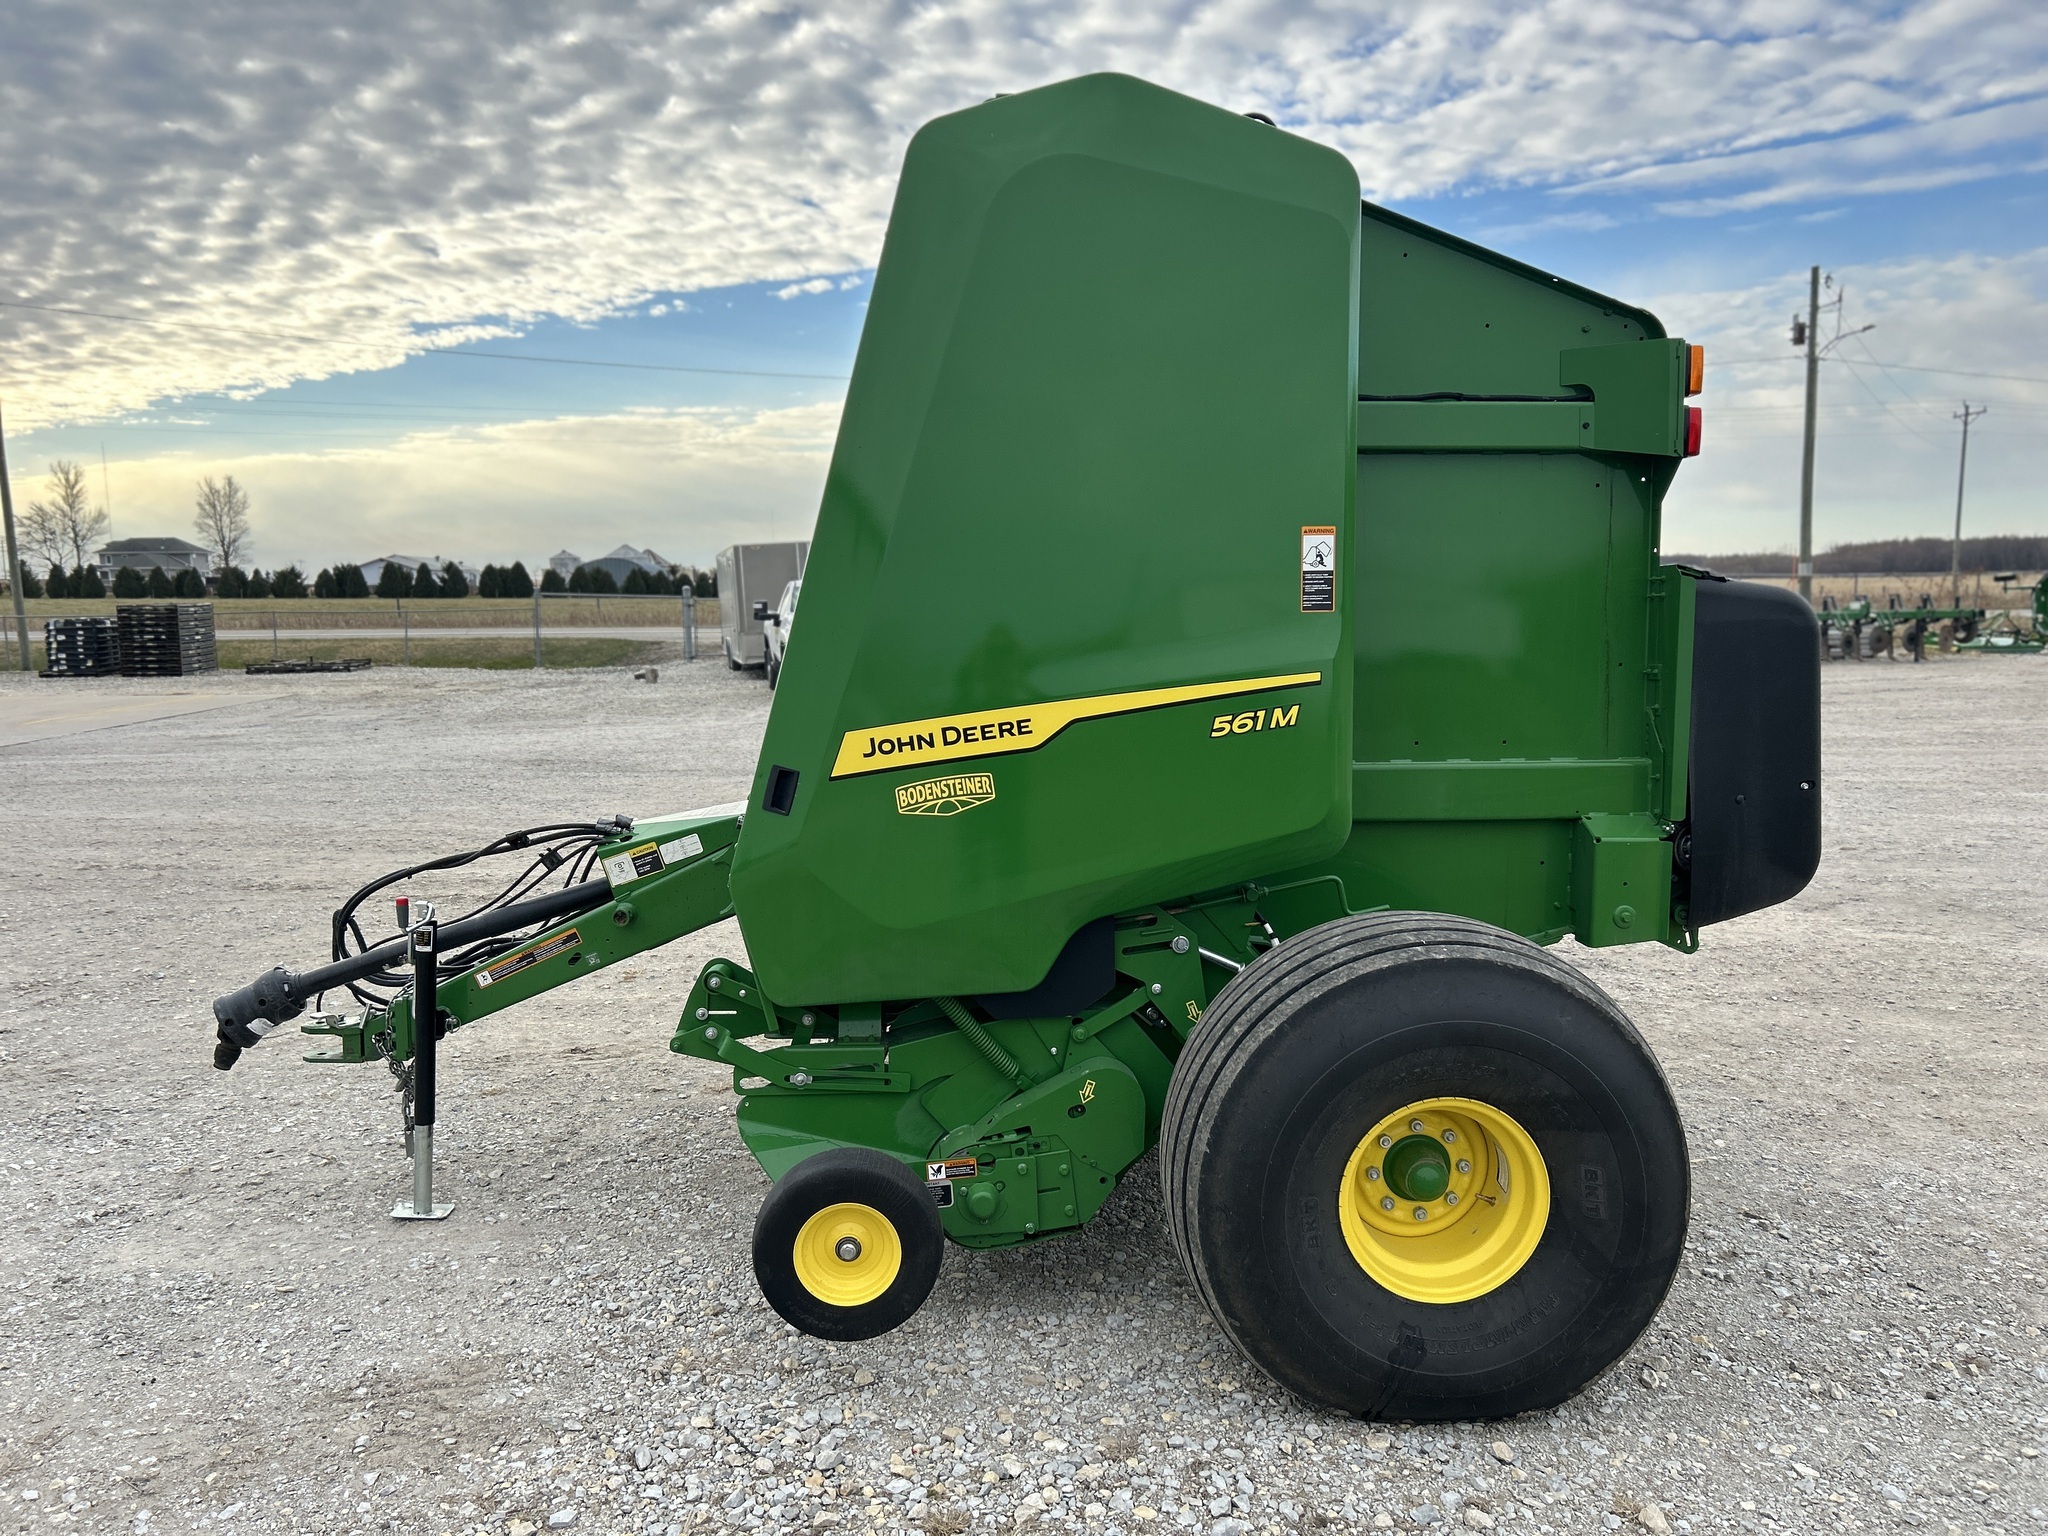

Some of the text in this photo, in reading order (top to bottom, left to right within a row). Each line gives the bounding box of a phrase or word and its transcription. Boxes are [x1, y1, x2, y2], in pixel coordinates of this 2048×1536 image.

[862, 718, 1034, 758] JOHN DEERE
[1210, 708, 1267, 739] 561
[898, 776, 992, 807] BODENSTEINER
[1583, 1167, 1604, 1219] BKT
